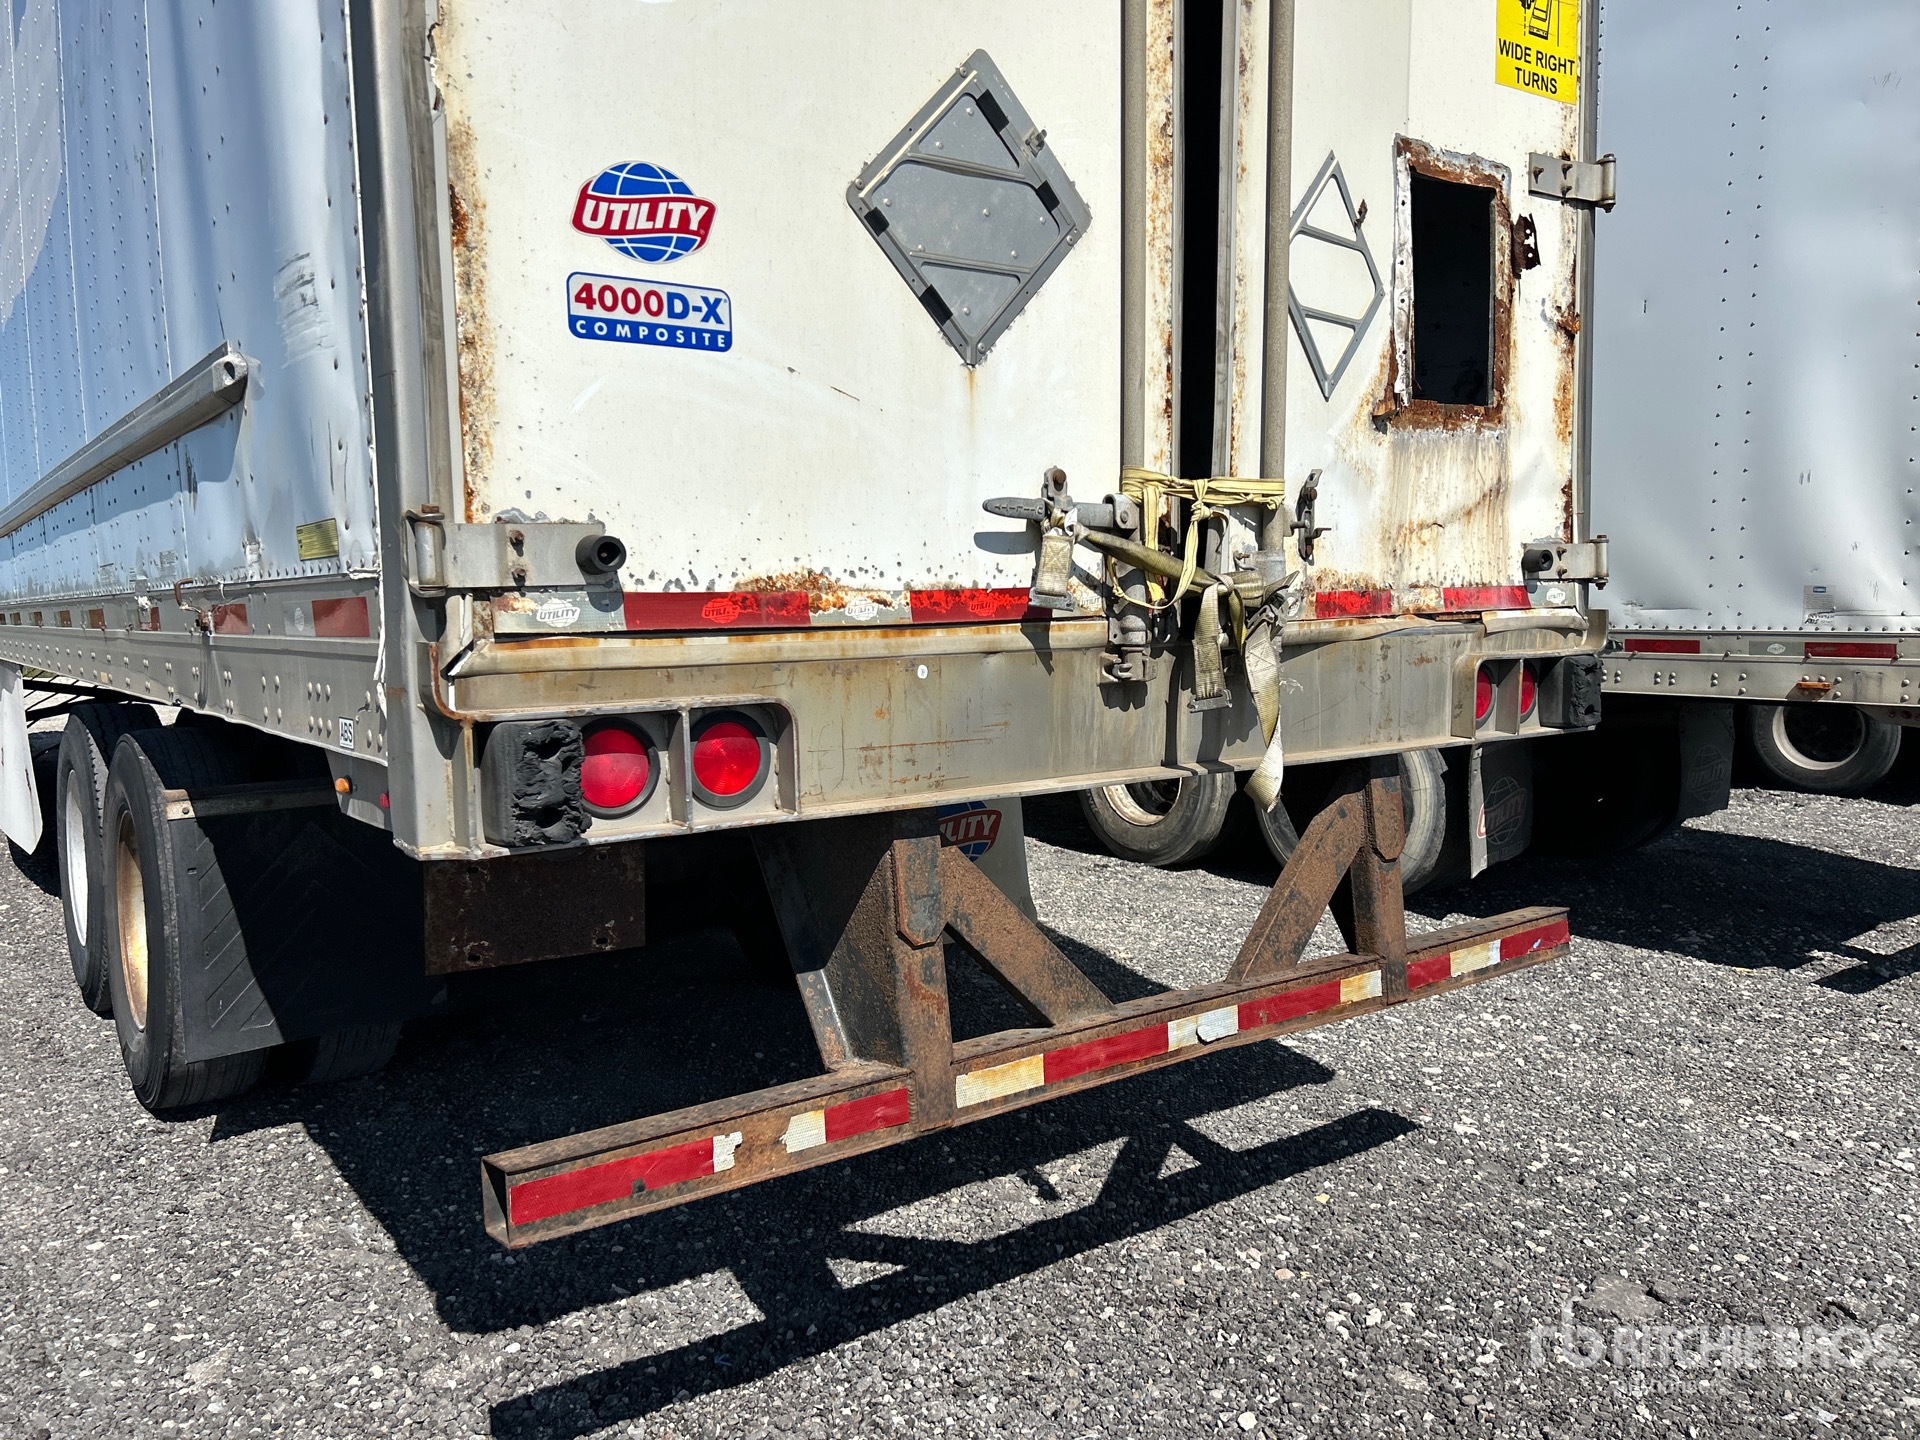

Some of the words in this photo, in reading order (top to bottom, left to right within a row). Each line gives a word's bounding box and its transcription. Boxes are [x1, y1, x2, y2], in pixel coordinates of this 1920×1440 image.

[1498, 38, 1532, 64] WIDE
[1535, 50, 1576, 76] RIGHT
[1514, 66, 1558, 94] TURNS
[581, 198, 709, 231] UTILITY
[574, 283, 725, 325] 4000D-X
[575, 320, 726, 348] COMPOSITE
[539, 608, 578, 620] UTILITY
[340, 722, 353, 743] ABS
[940, 814, 997, 842] LITY
